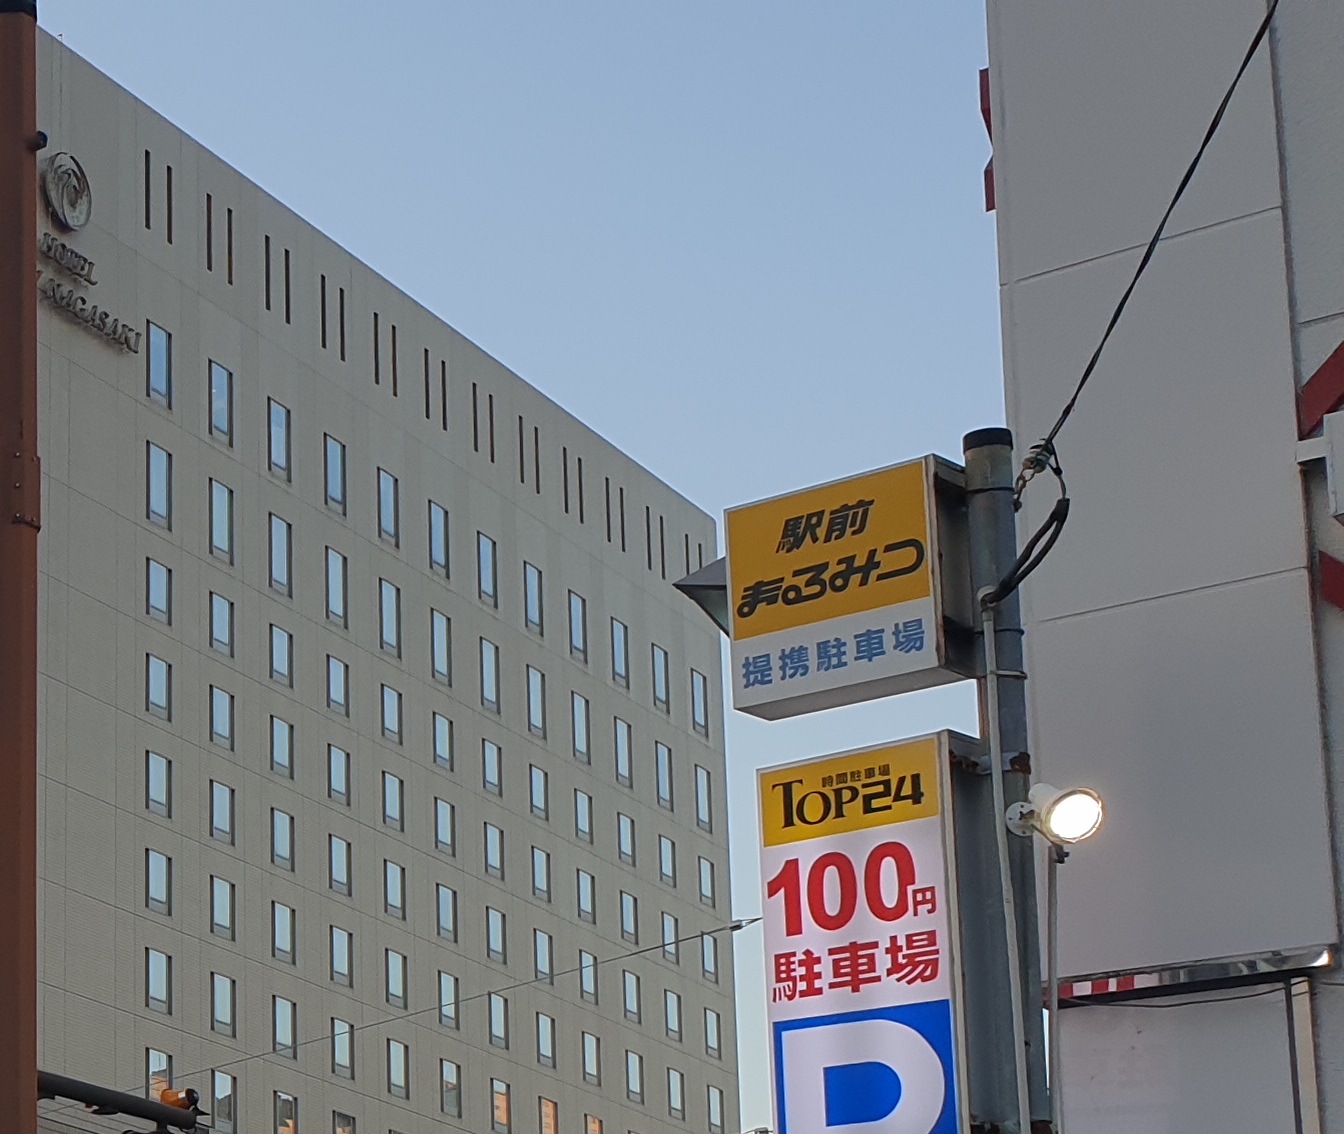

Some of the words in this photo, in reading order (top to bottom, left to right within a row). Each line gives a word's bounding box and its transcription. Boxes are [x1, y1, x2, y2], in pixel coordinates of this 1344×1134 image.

[39, 278, 142, 354] NAGASAKI
[775, 498, 875, 554] 駅前
[737, 538, 925, 618] まるみつ
[742, 617, 926, 689] 提携駐車場
[821, 763, 892, 788] 時間駐車場
[772, 930, 940, 1003] 駐車場
